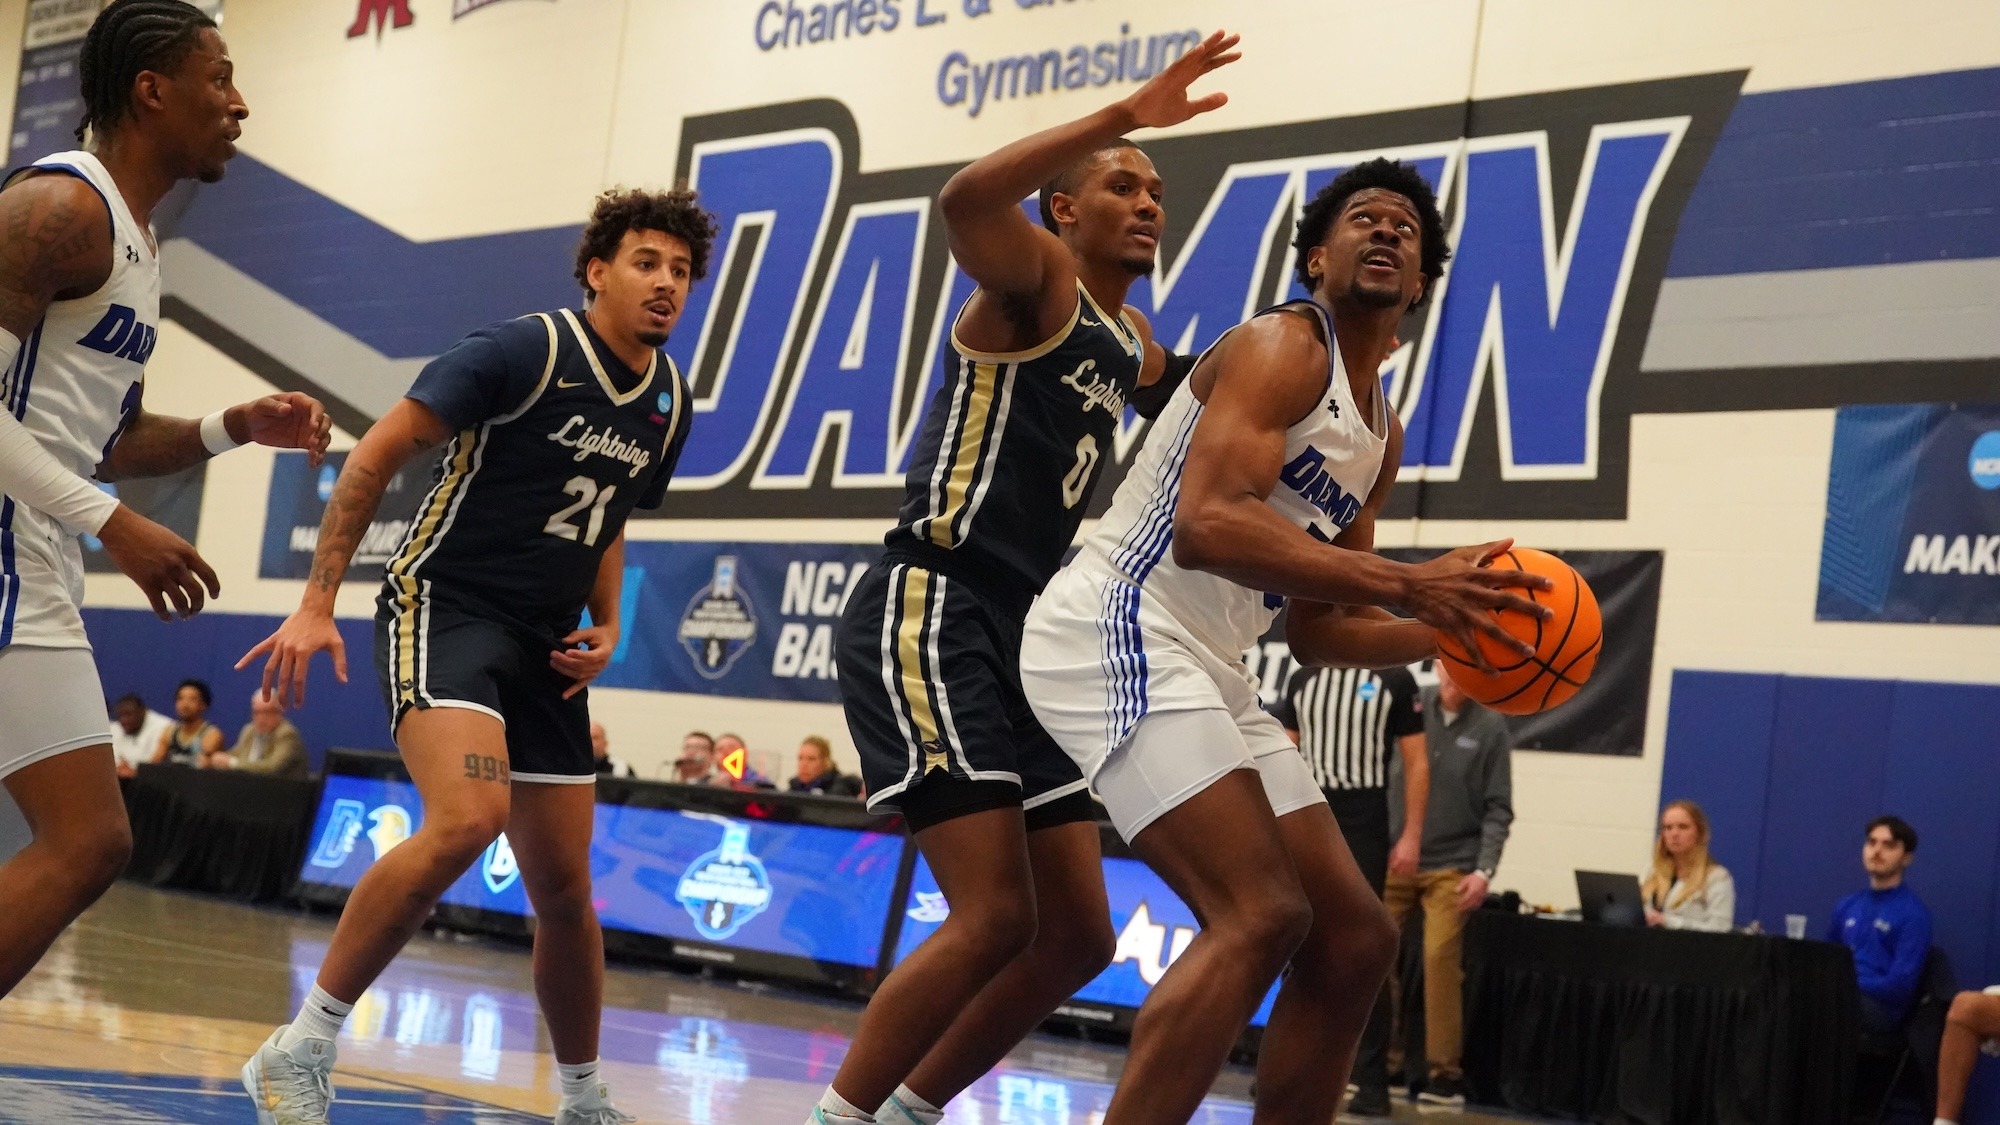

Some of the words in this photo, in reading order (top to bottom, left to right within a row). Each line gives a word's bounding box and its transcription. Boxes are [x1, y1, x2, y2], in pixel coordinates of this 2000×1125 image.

[755, 0, 899, 51] Charles
[936, 22, 1202, 118] Gymnasium
[547, 414, 650, 478] Lightning
[1062, 432, 1099, 510] 0
[542, 474, 617, 547] 21
[1903, 533, 2000, 575] MAK
[463, 753, 509, 785] 999
